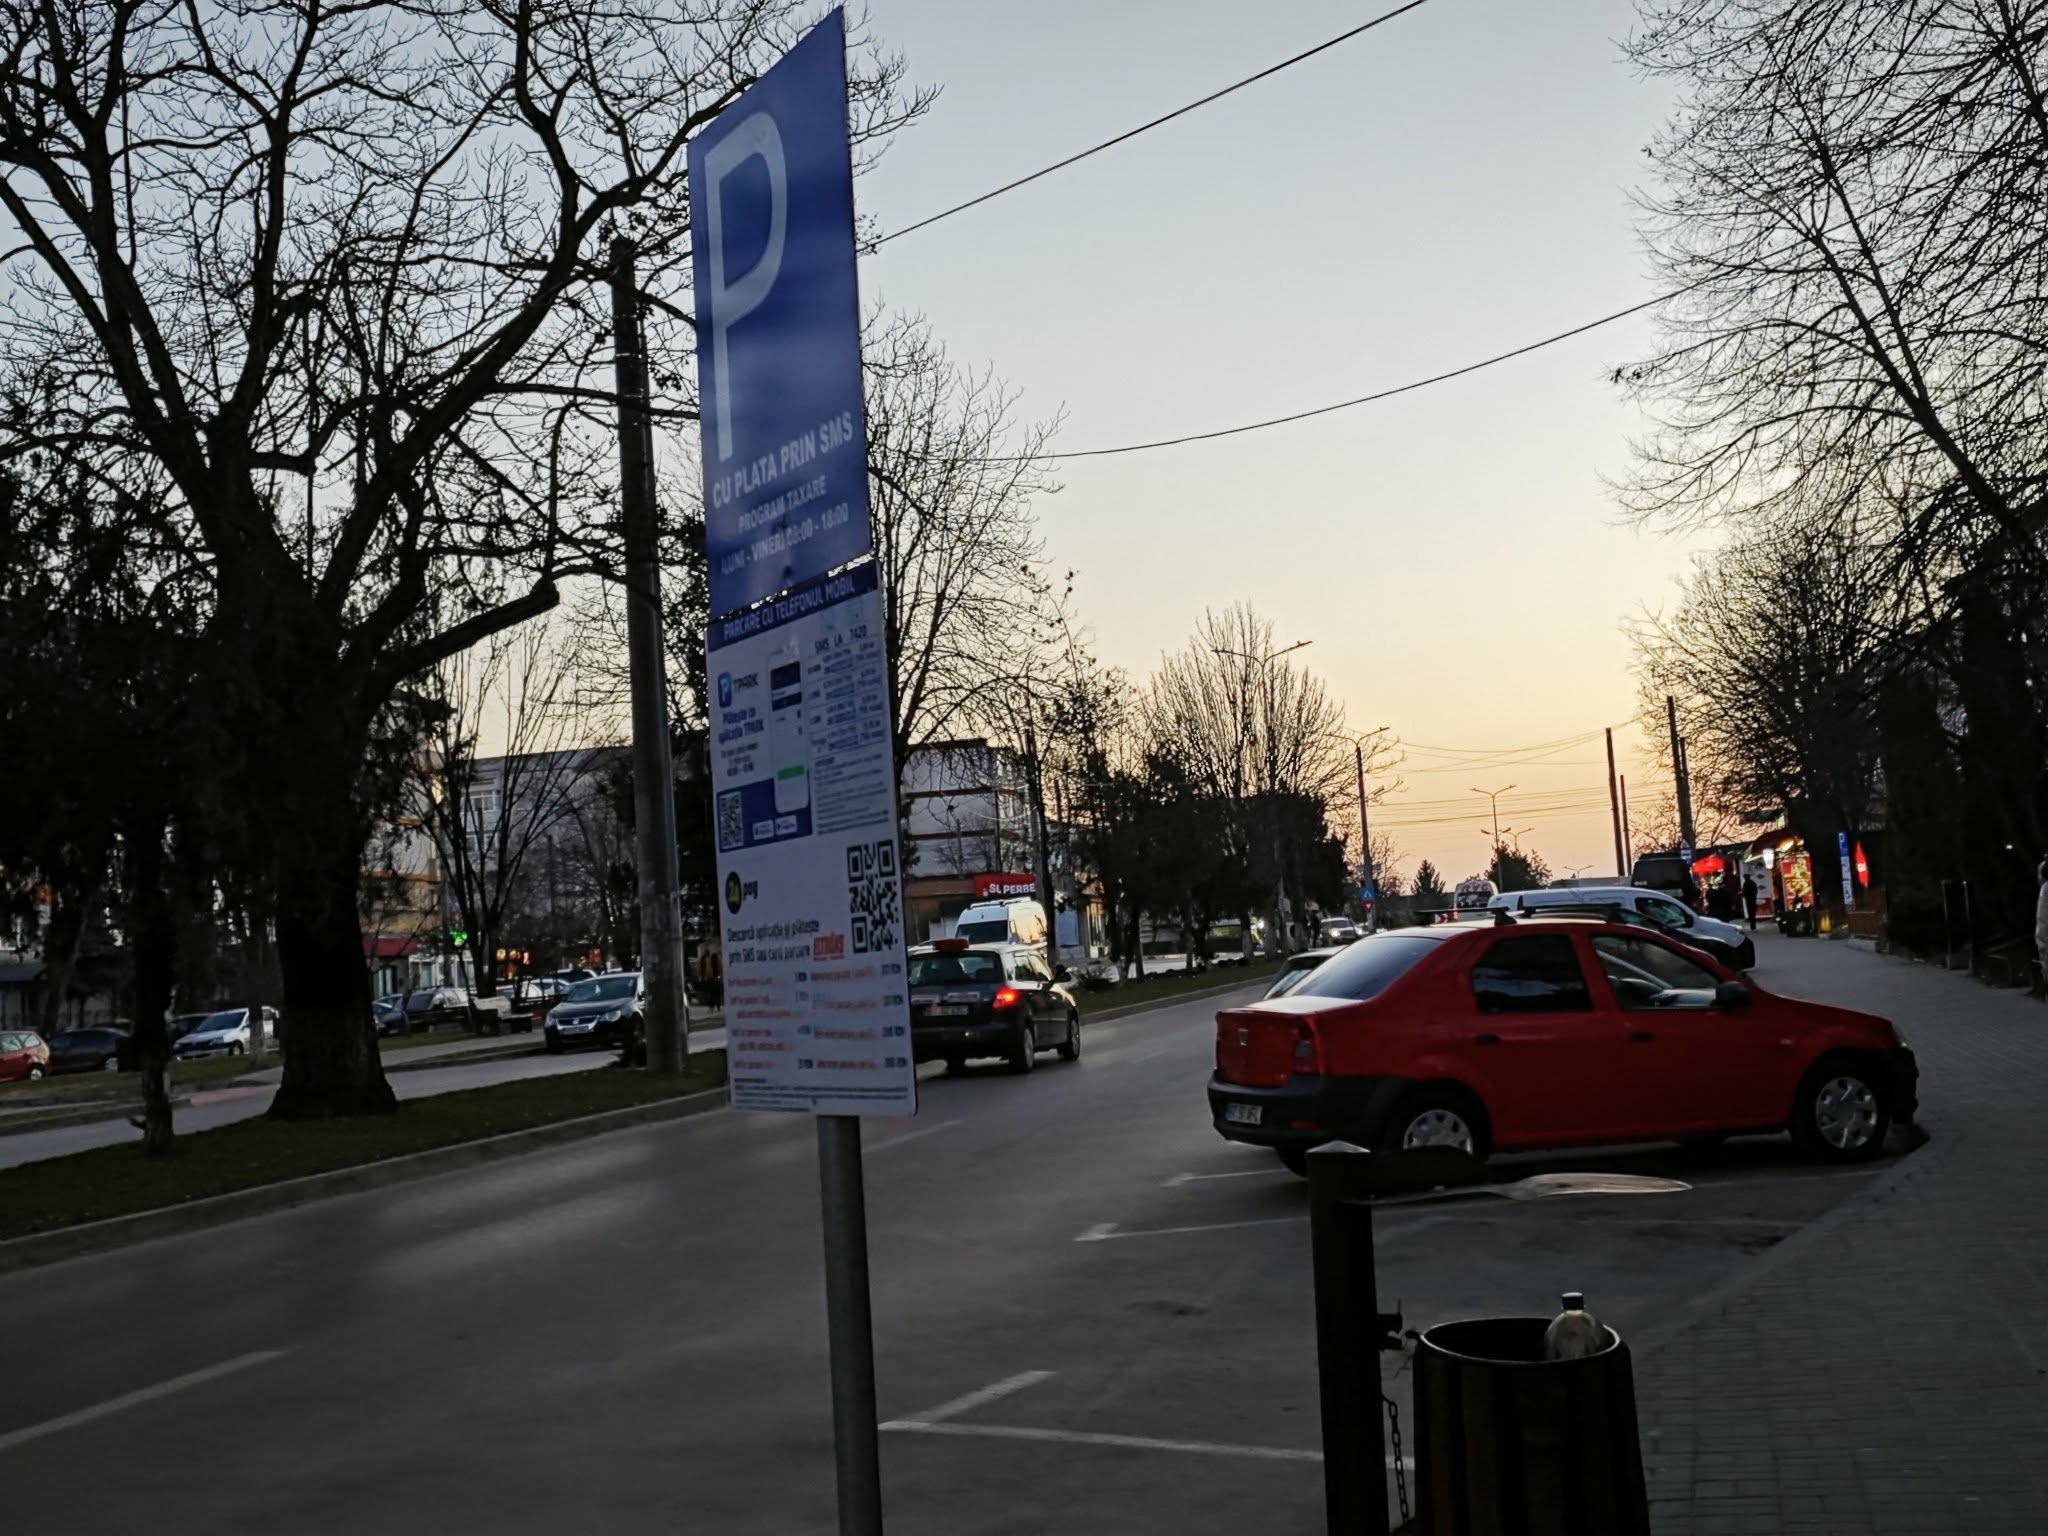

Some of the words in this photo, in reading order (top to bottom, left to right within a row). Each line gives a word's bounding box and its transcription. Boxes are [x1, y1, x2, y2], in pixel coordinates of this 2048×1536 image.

[704, 111, 788, 462] P
[713, 481, 730, 509] CU
[735, 453, 779, 498] PLATA
[780, 429, 816, 473] PRIN
[820, 411, 854, 454] SMS
[739, 497, 785, 532] PROGRAM
[787, 476, 826, 510] TAXARE
[751, 533, 785, 561] VINERI
[724, 612, 761, 641] PARCARE
[762, 608, 775, 625] CU
[775, 584, 825, 621] TELEFONUL
[825, 574, 856, 602] MOBIL
[989, 883, 1036, 894] SUPERBE
